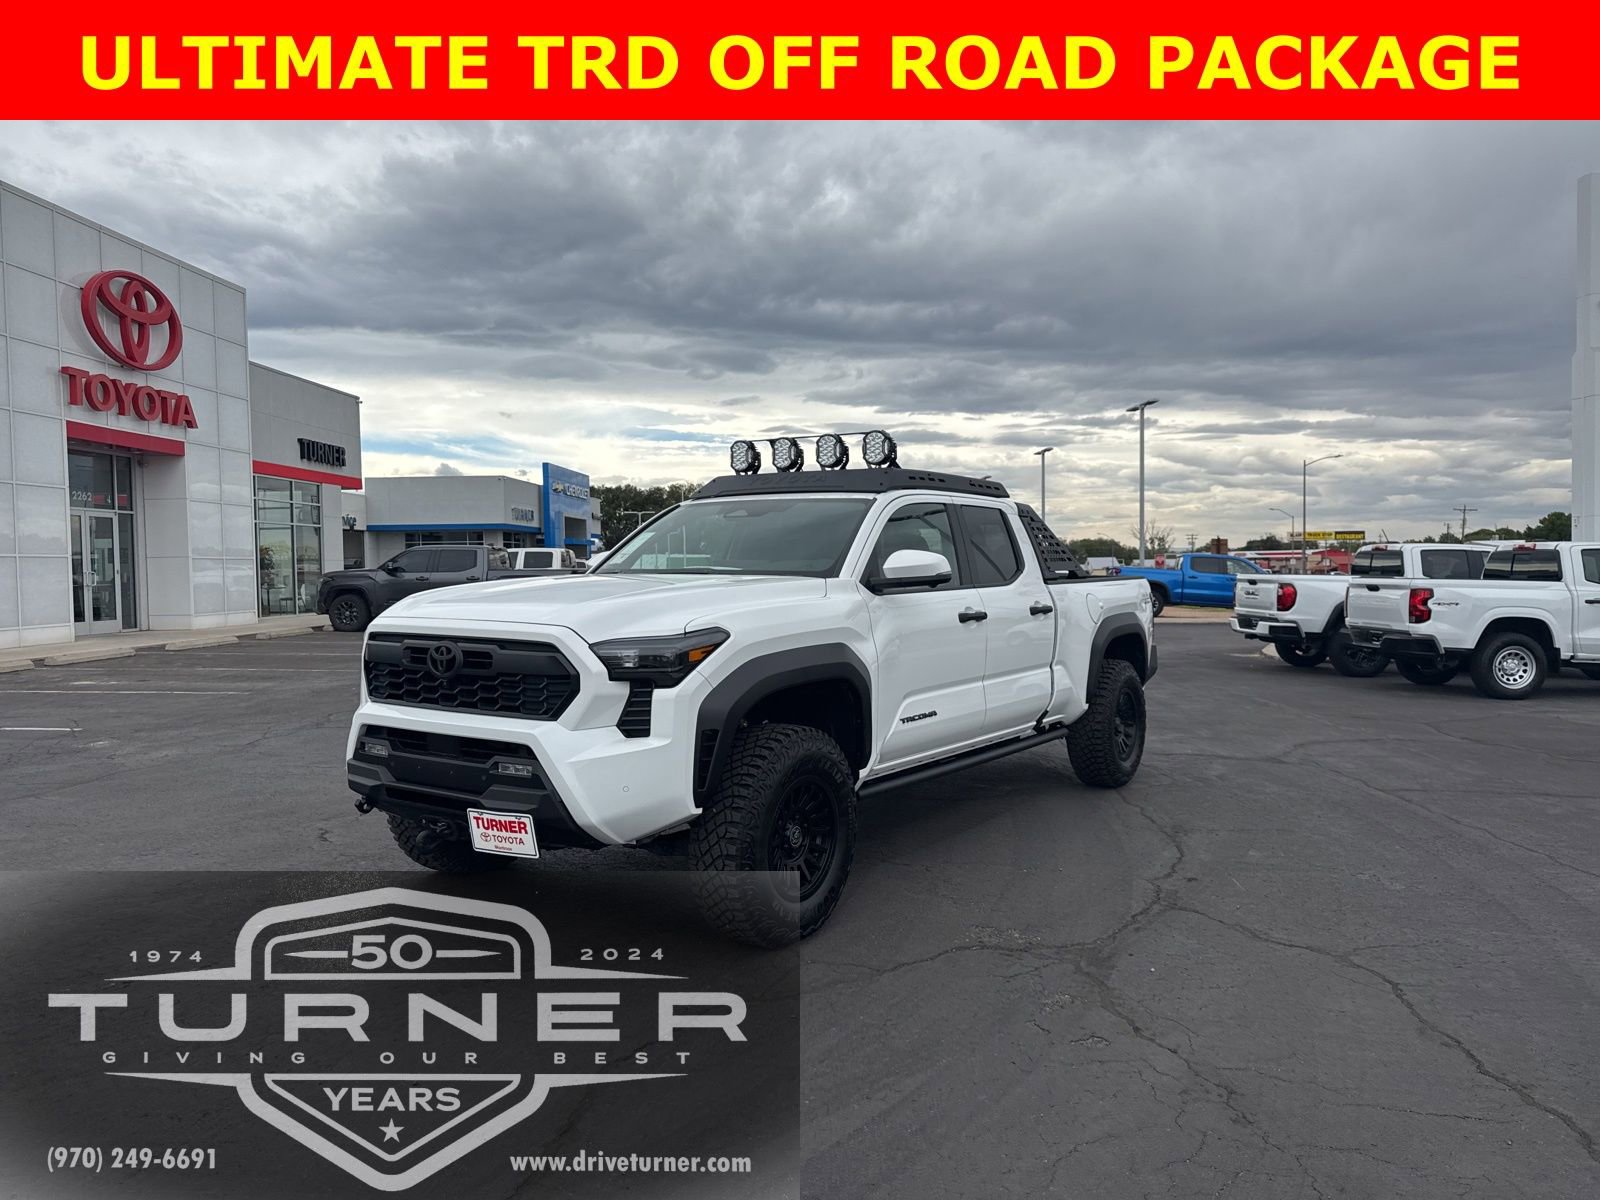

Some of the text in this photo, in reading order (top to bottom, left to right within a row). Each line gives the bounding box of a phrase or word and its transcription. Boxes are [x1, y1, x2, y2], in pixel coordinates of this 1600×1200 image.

[61, 366, 199, 429] TOYOTA
[297, 438, 346, 467] TURNER
[72, 490, 92, 501] 2262
[342, 513, 357, 527] vice
[900, 710, 937, 724] TACOMA
[473, 816, 528, 834] TURNER
[492, 835, 525, 845] TOYOTA
